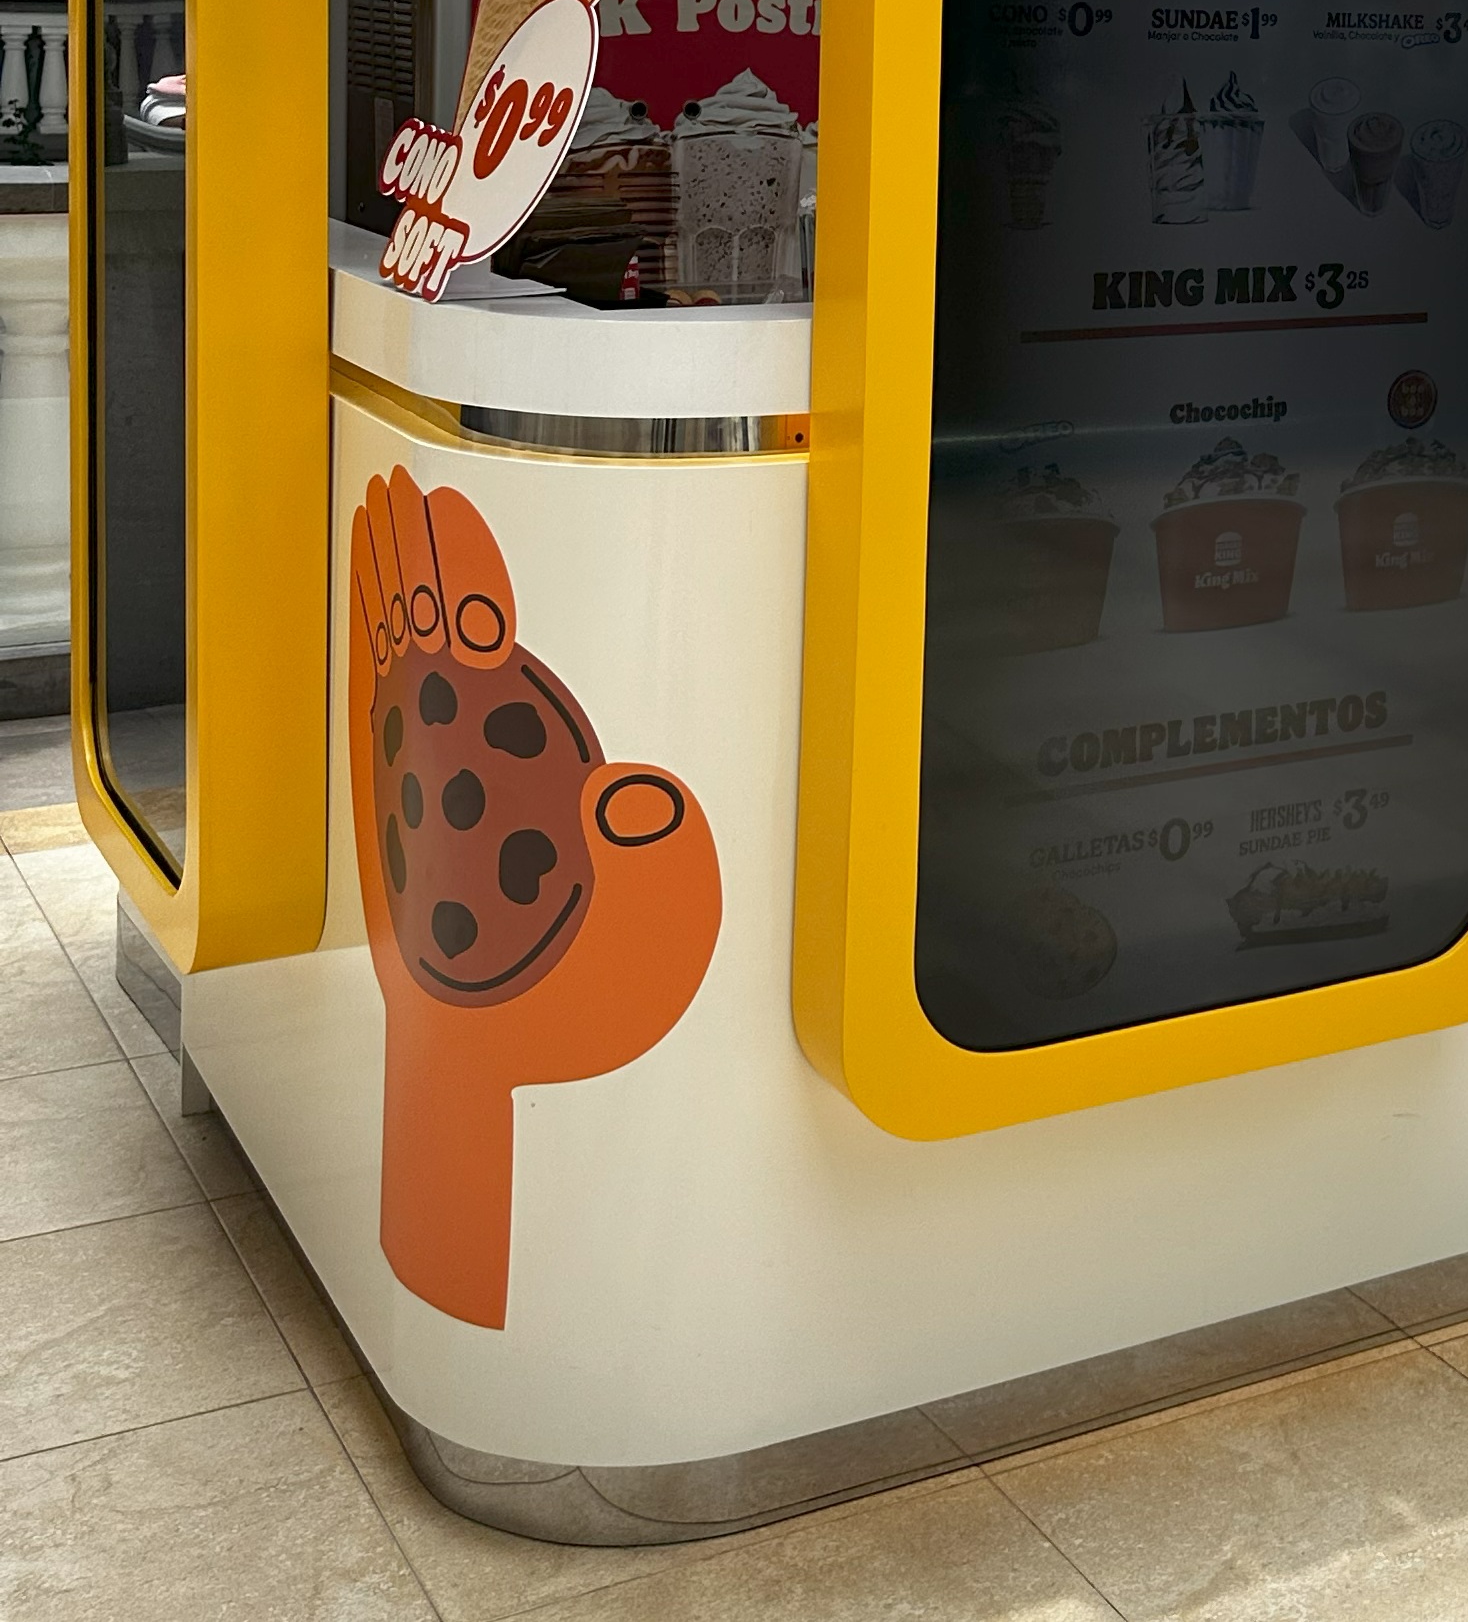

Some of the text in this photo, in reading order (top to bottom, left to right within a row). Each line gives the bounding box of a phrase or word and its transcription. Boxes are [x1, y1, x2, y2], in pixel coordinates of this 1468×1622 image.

[989, 2, 1049, 24] CONO
[1150, 8, 1240, 32] SUNDAE
[1325, 11, 1425, 32] MILKSHAKE
[1147, 30, 1181, 43] Manjar
[1191, 30, 1239, 42] Chocolate
[381, 126, 460, 206] CONO
[382, 208, 467, 294] SOFT
[1091, 268, 1206, 311] KING
[1213, 264, 1299, 306] MIX
[1169, 395, 1289, 425] Chocochip
[1193, 571, 1231, 591] King
[1037, 690, 1388, 778] COMPLEMENTOS
[1028, 830, 1146, 869] GALLETAS
[1238, 826, 1332, 858] SUNDAE PIE
